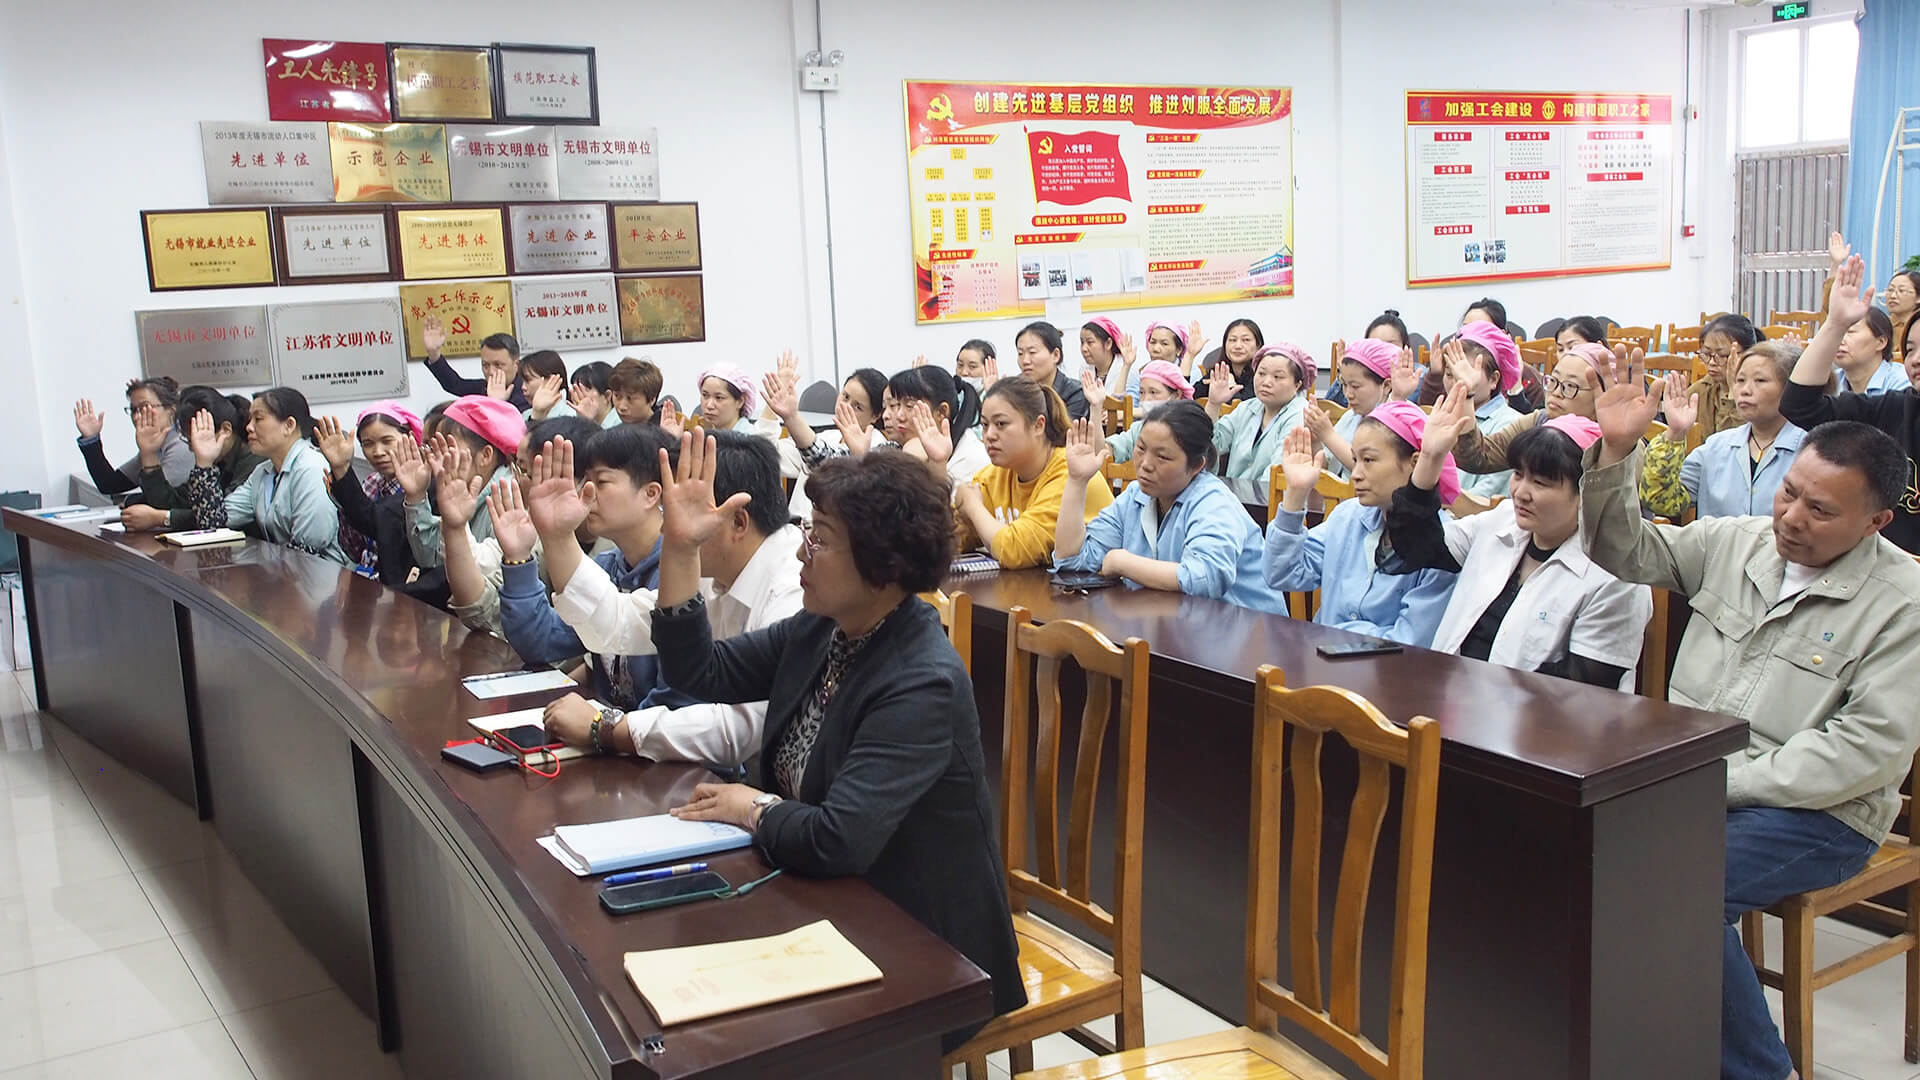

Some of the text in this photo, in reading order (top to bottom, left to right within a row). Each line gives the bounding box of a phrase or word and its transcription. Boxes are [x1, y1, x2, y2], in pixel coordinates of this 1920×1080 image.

[278, 58, 378, 91] 工人先锋号
[513, 71, 580, 87] 模范职工之家
[974, 91, 1273, 117] 创建先进基层党组织 推进刘服全面发展
[1445, 101, 1533, 117] 加强工会建设
[564, 140, 651, 155] 无锡市文明单位
[231, 151, 310, 168] 先进单位
[347, 148, 433, 167] 示范企业
[165, 234, 257, 251] 无锡市就业先进企业
[303, 235, 372, 251] 先进单位
[418, 232, 488, 250] 先进集体
[527, 228, 597, 244] 先进企业
[627, 228, 687, 243] 平安企业
[525, 303, 608, 319] 无锡市文明单位
[154, 324, 256, 344] 无锡市文明单位
[286, 330, 393, 351] 江苏省文明单位
